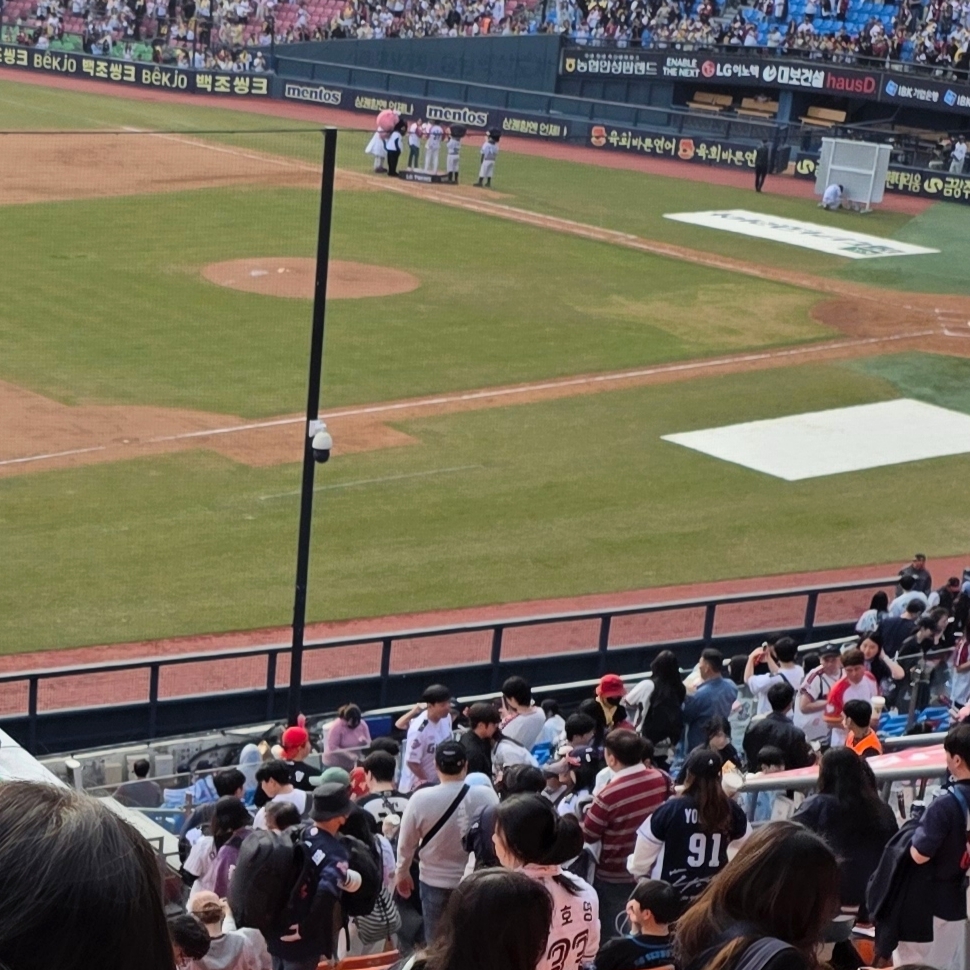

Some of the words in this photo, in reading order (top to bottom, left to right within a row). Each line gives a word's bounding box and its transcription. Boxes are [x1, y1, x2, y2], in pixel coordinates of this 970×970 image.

[82, 58, 136, 82] 백조씽크
[196, 74, 268, 95] 백조씽크
[778, 65, 825, 88] 대보건설
[285, 83, 341, 105] mentos
[426, 105, 489, 127] mentos
[608, 130, 677, 156] 육회바른연어
[696, 143, 757, 167] 육회바른연
[943, 176, 970, 200] 금강주
[687, 832, 722, 867] 91
